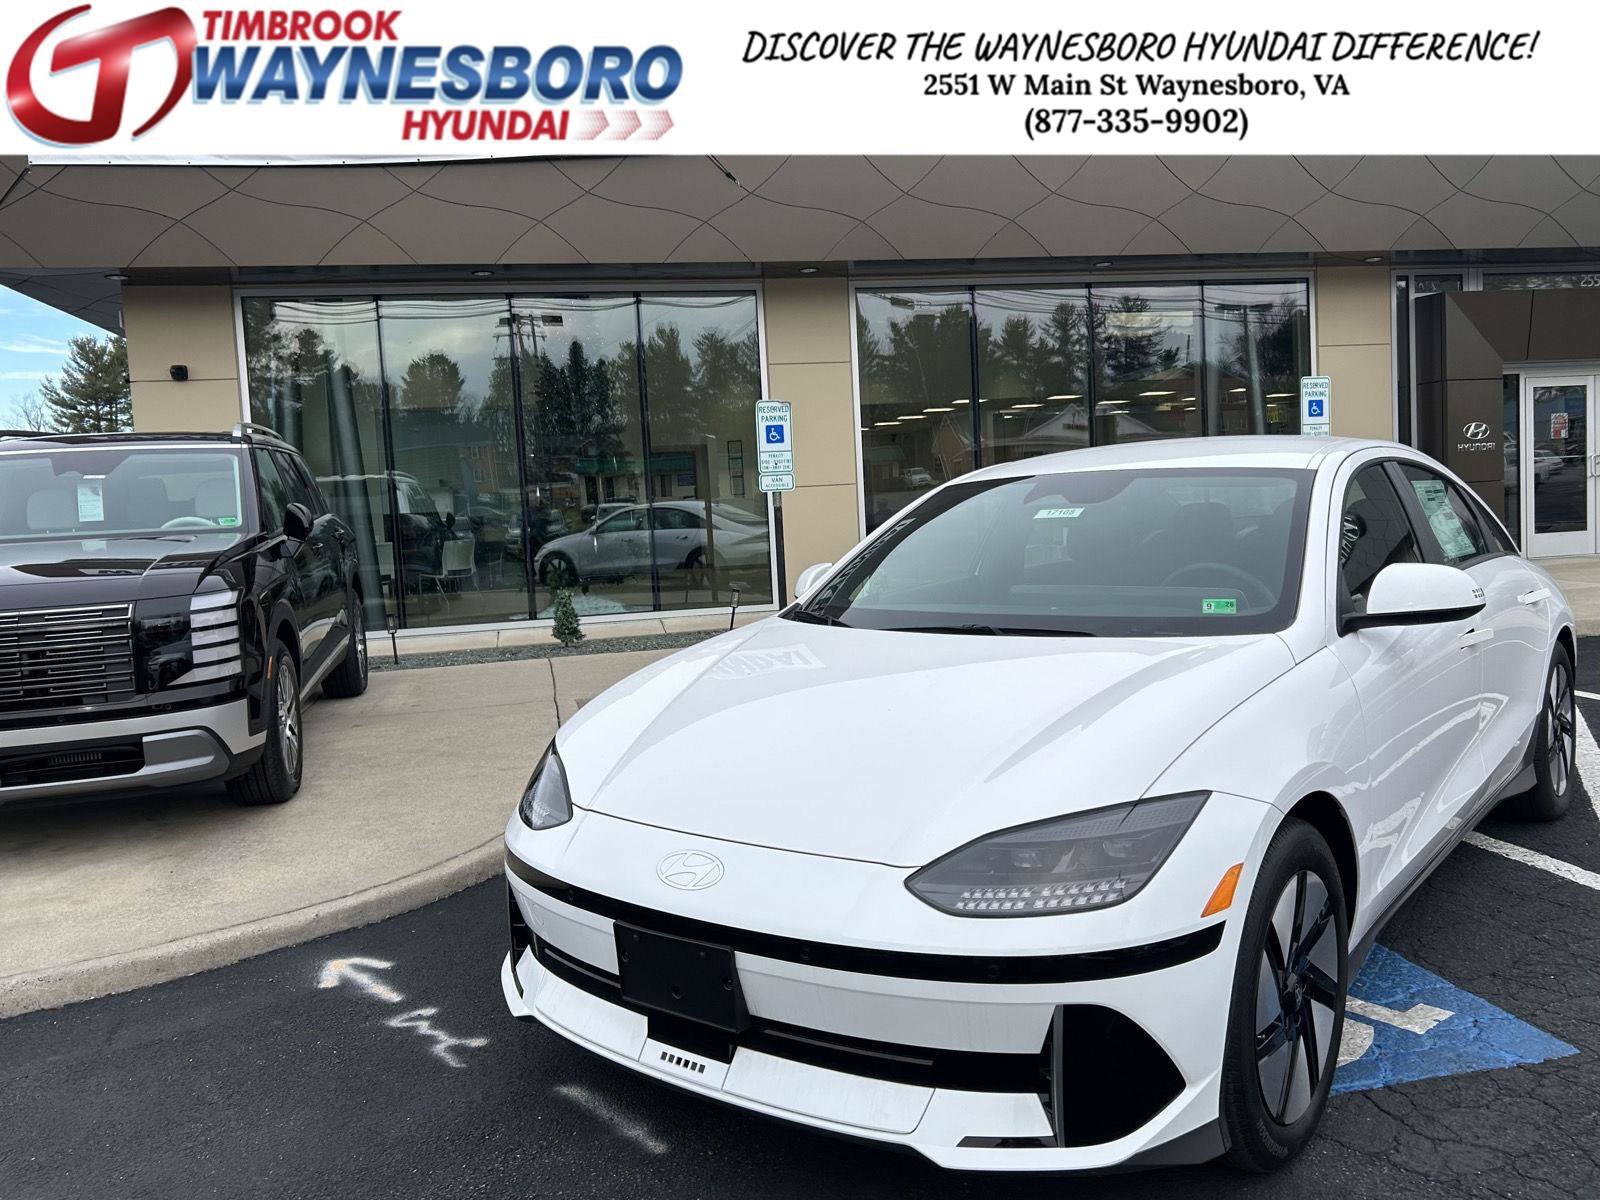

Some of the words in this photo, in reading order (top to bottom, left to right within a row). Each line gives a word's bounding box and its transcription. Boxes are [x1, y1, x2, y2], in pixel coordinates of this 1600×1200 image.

[1304, 390, 1327, 398] PARKING
[759, 405, 790, 414] RESERVED
[761, 415, 788, 423] PARKING
[1457, 442, 1496, 452] HYUNDAI
